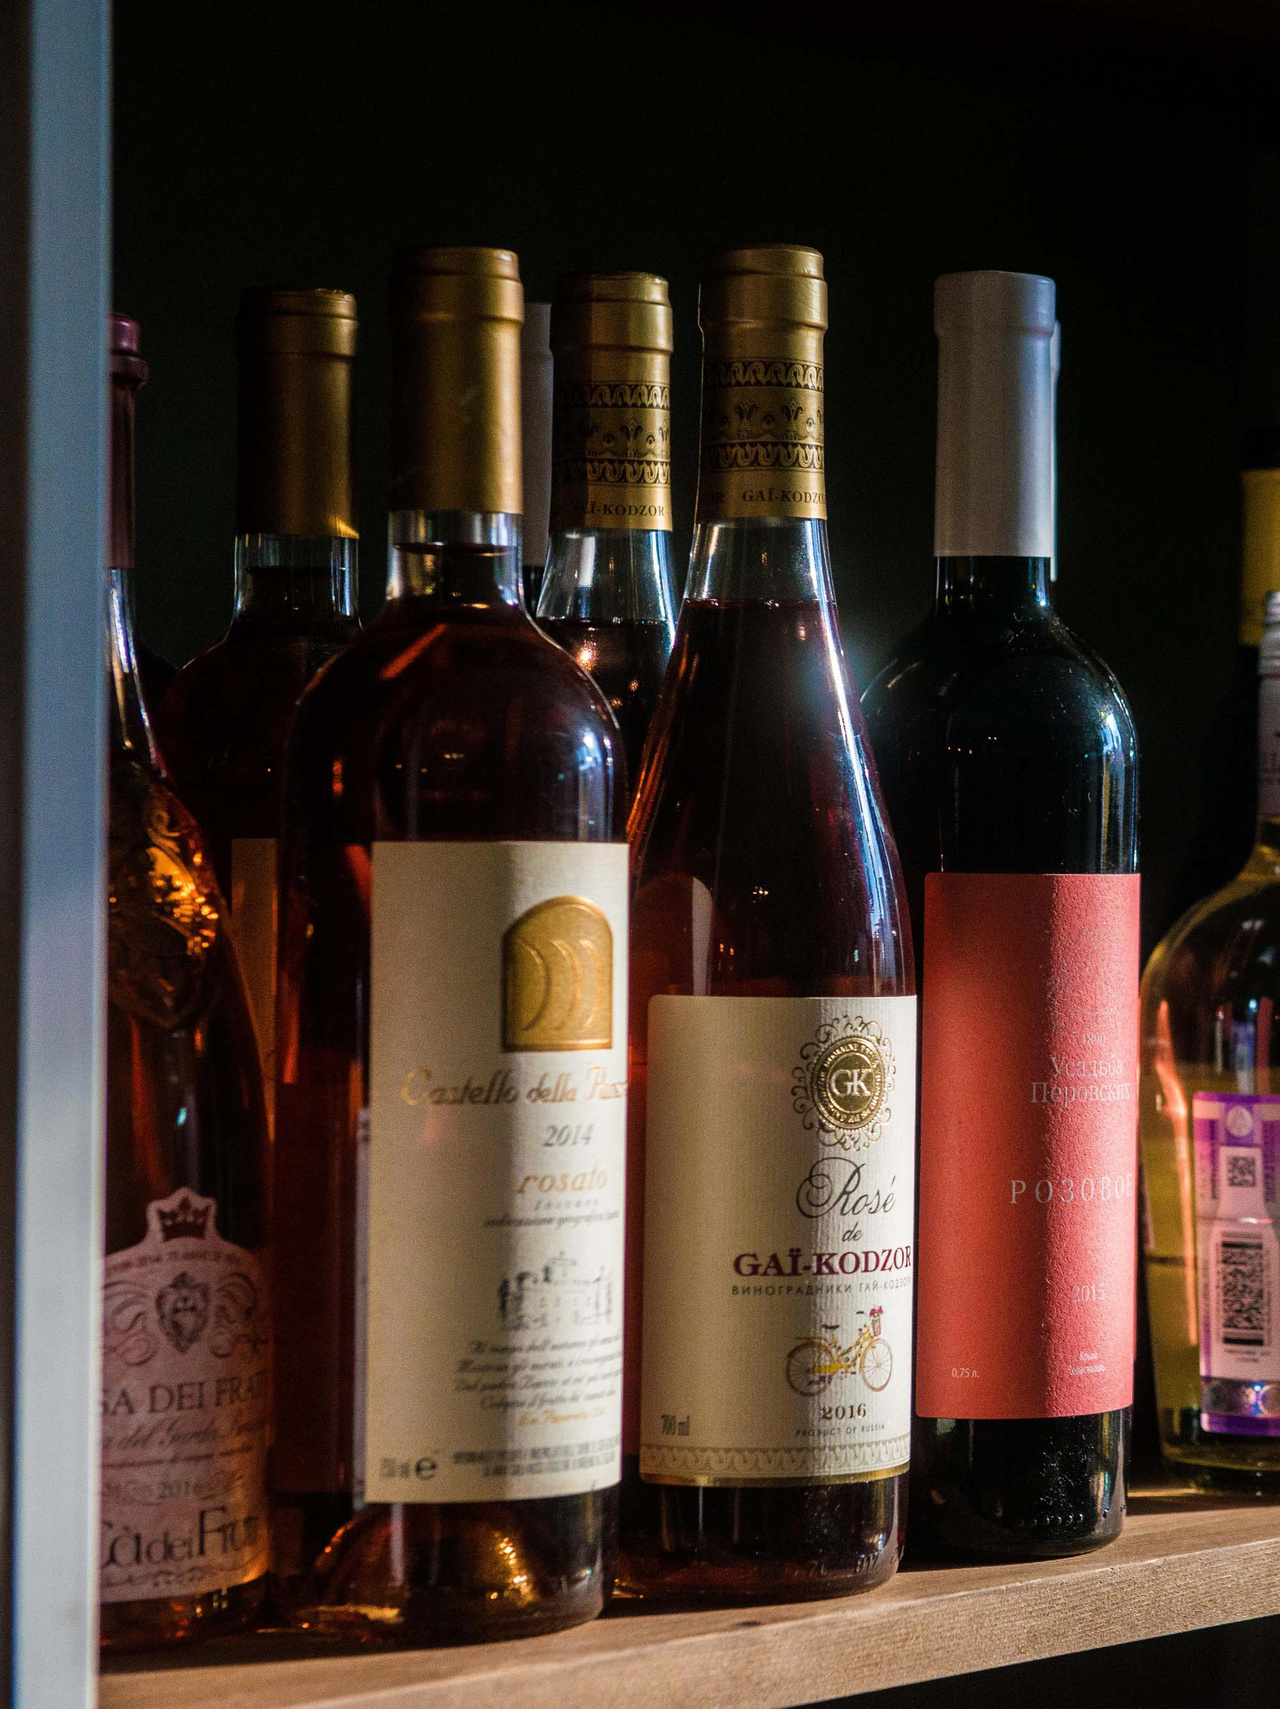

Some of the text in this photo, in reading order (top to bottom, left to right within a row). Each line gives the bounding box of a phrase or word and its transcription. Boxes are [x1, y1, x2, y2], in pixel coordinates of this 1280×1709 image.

[574, 501, 665, 517] GÏ-KODZOR
[1050, 1054, 1124, 1078] Усадьба
[401, 1066, 519, 1106] Castello
[525, 1072, 579, 1104] della
[829, 1068, 874, 1096] GK
[1030, 1082, 1131, 1109] Перовских
[542, 1124, 594, 1147] 2014
[516, 1160, 607, 1195] rosato
[796, 1157, 897, 1219] Rosé
[841, 1222, 863, 1242] de
[733, 1245, 911, 1278] GAÏ-KODZOR
[731, 1284, 851, 1297] ВИНОГРАДНИКИ
[1072, 1284, 1106, 1303] 2015
[951, 1368, 970, 1380] 0,75
[149, 1381, 205, 1416] DEI
[821, 1403, 867, 1421] 2016
[795, 1423, 885, 1438] PRODUCT OF RUSSIA
[146, 1529, 193, 1565] dei
